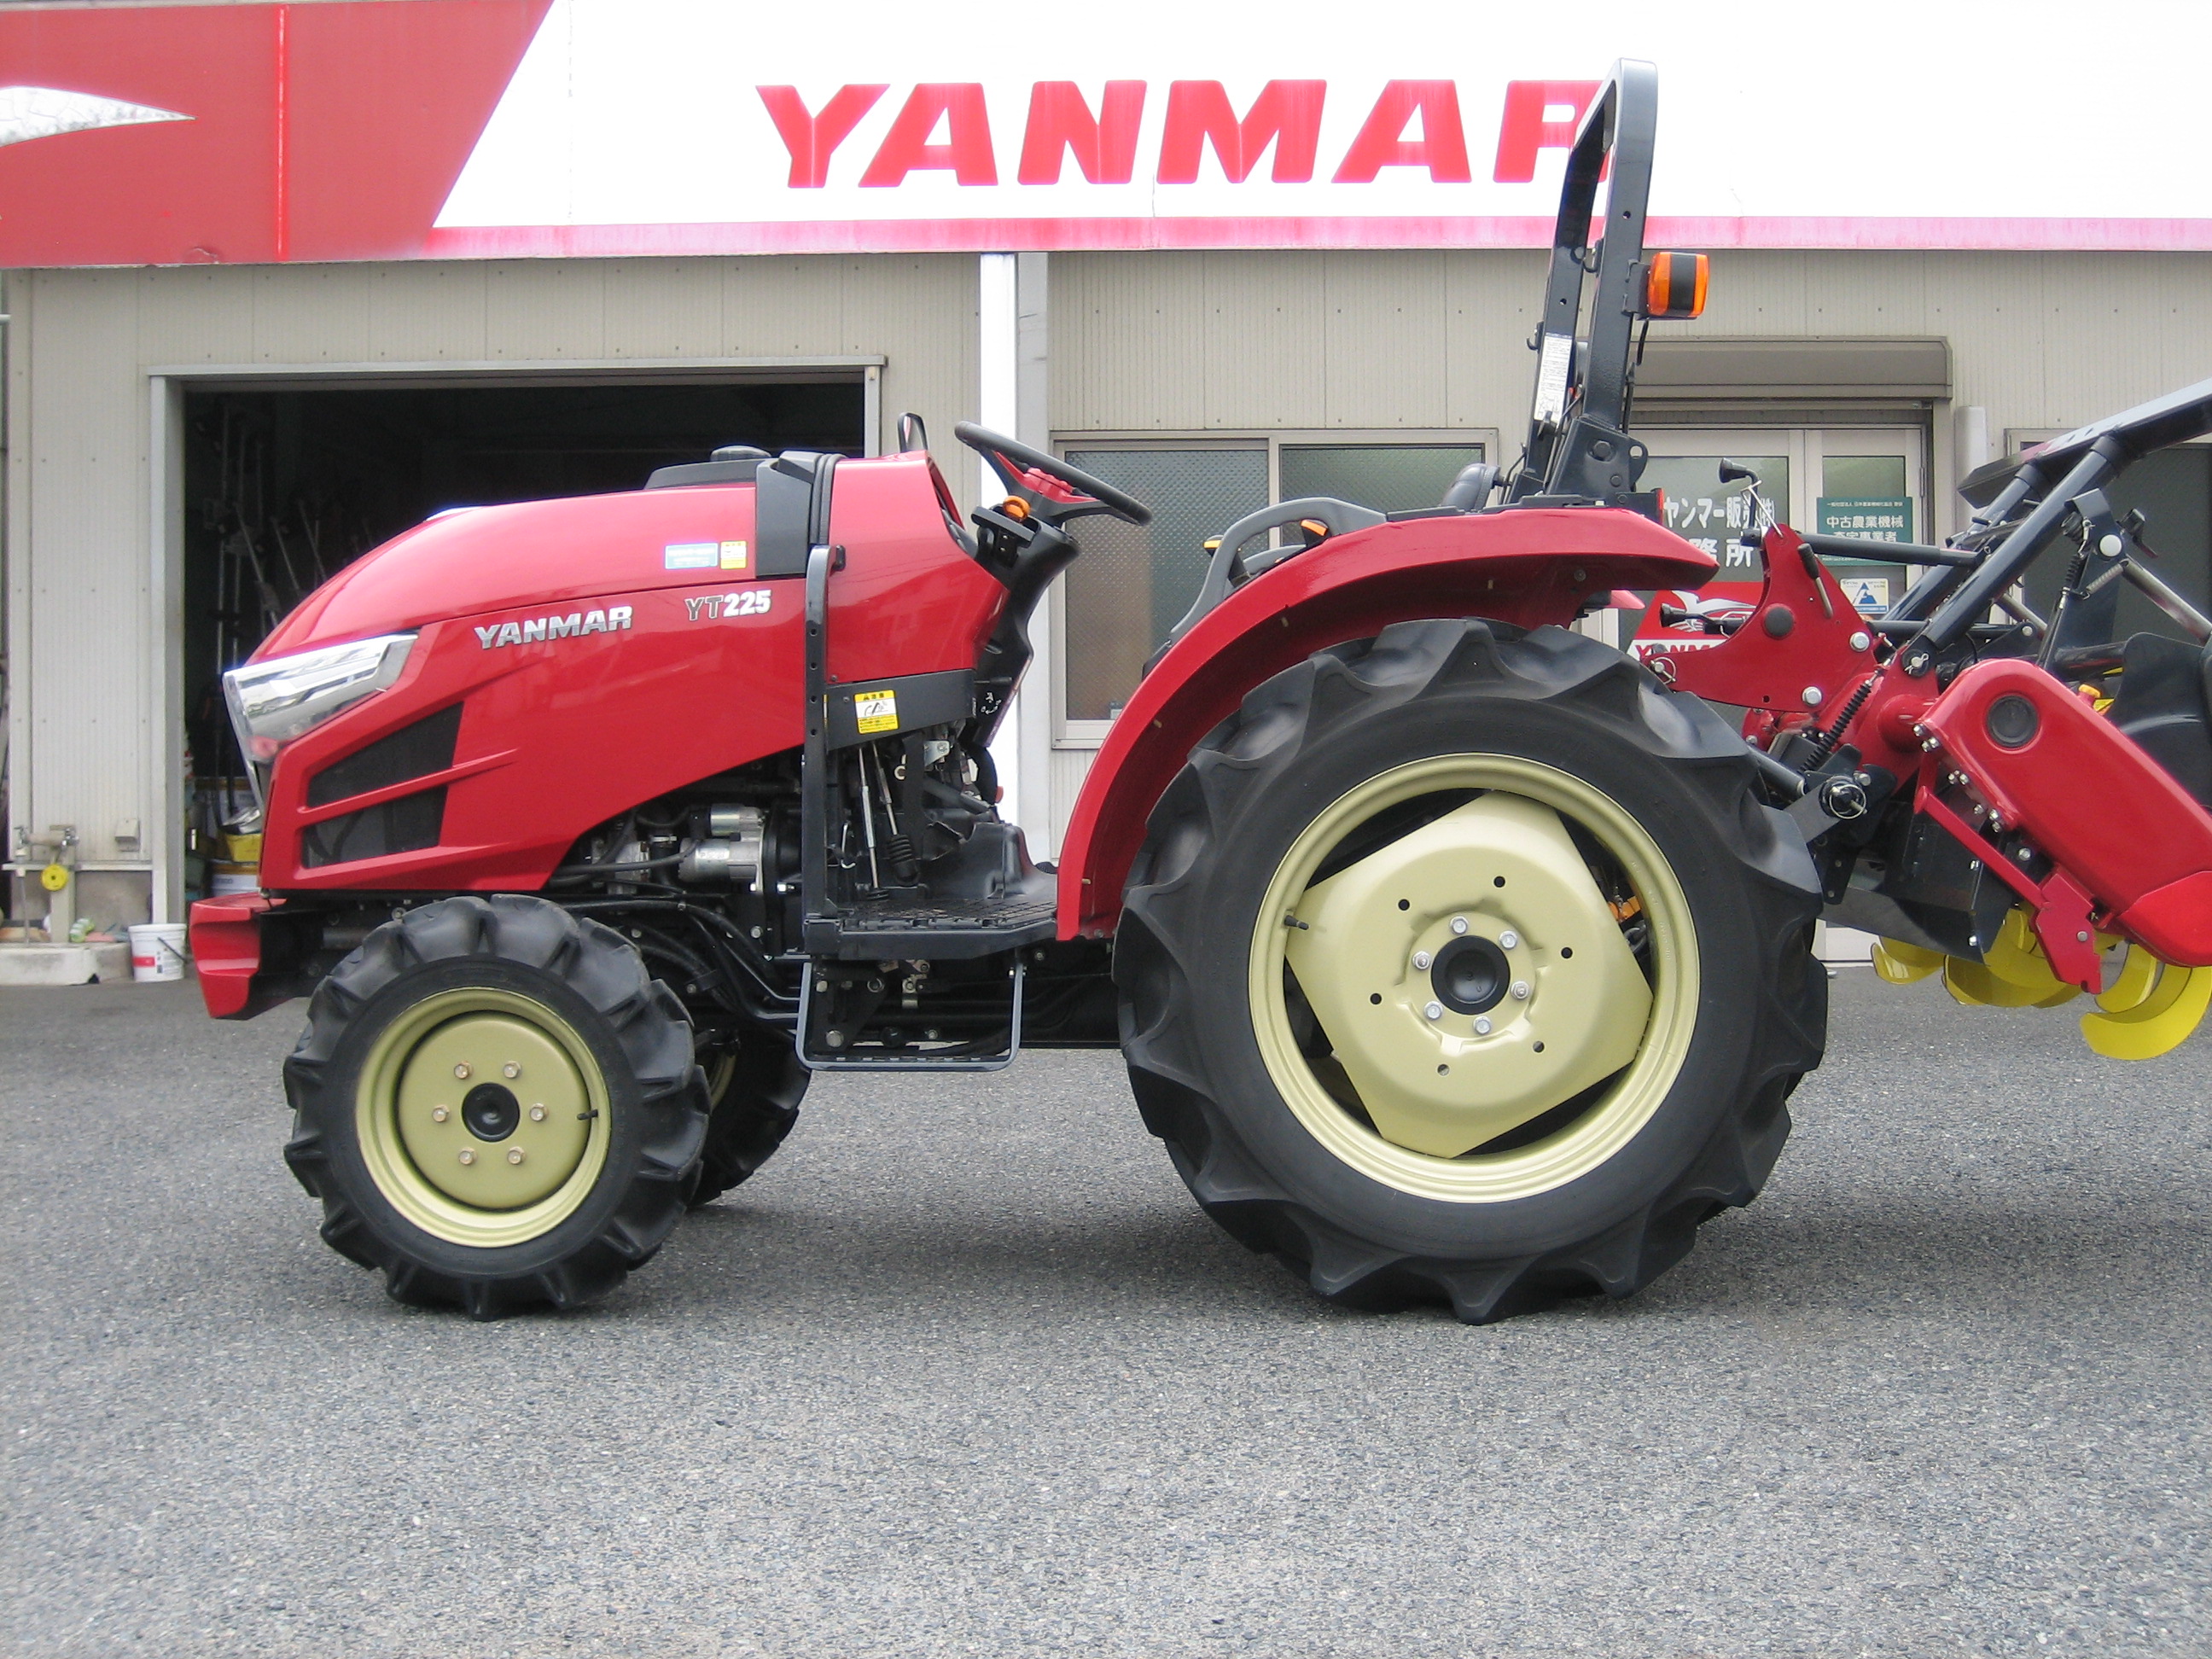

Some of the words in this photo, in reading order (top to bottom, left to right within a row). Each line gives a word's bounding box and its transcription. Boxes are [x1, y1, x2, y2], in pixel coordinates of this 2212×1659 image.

[755, 79, 1611, 188] YANMAR
[1826, 515, 1904, 528] 中古農業機械
[685, 590, 771, 621] YT225
[474, 606, 633, 649] YANMAR
